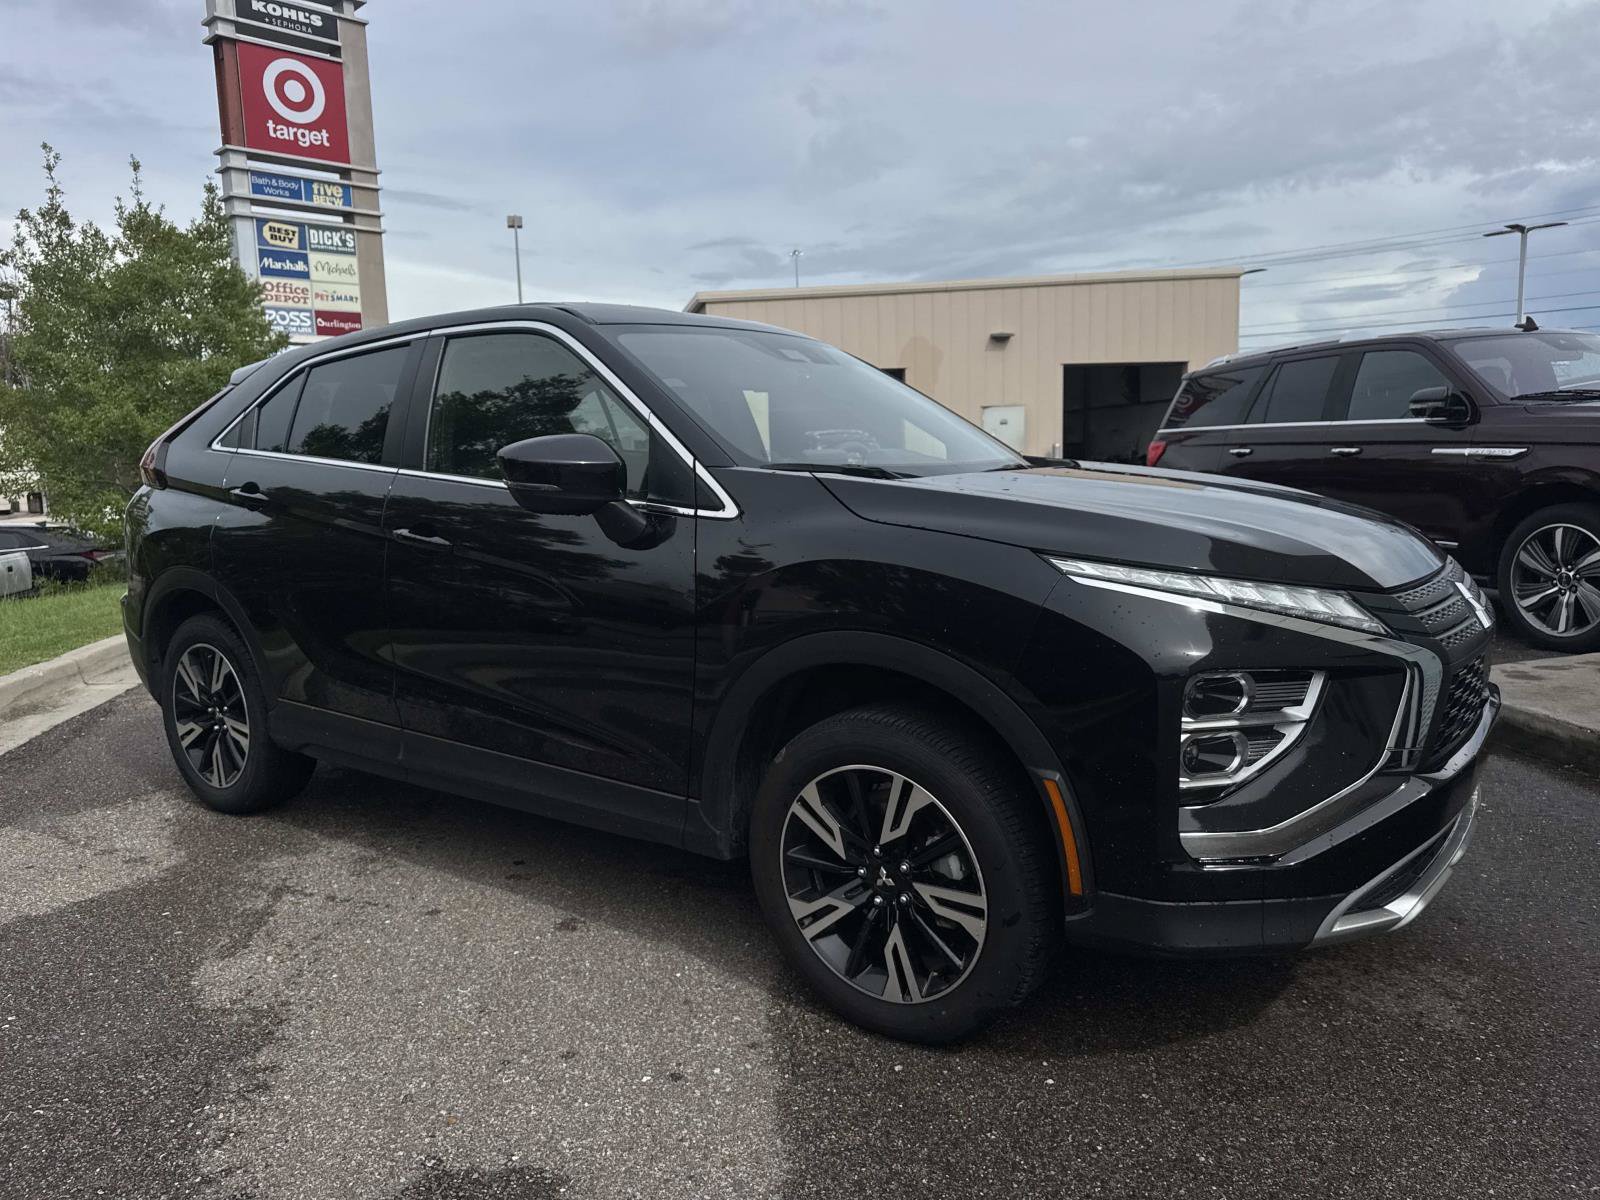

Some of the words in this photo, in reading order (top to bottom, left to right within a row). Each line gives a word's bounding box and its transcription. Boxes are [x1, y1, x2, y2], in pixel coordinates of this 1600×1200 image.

[251, 0, 323, 27] KOHL'S
[271, 17, 313, 34] SEPHORA
[266, 119, 330, 147] target
[251, 175, 271, 186] Bath
[271, 178, 278, 187] &
[278, 179, 299, 190] Body
[312, 181, 343, 197] five
[263, 186, 290, 197] Works
[268, 225, 297, 238] BEST
[270, 233, 295, 244] BUY
[309, 228, 355, 247] DICK'S
[260, 257, 309, 272] Marshalls
[313, 261, 356, 276] Michaels
[263, 281, 309, 295] Office
[264, 293, 310, 304] DEPOT
